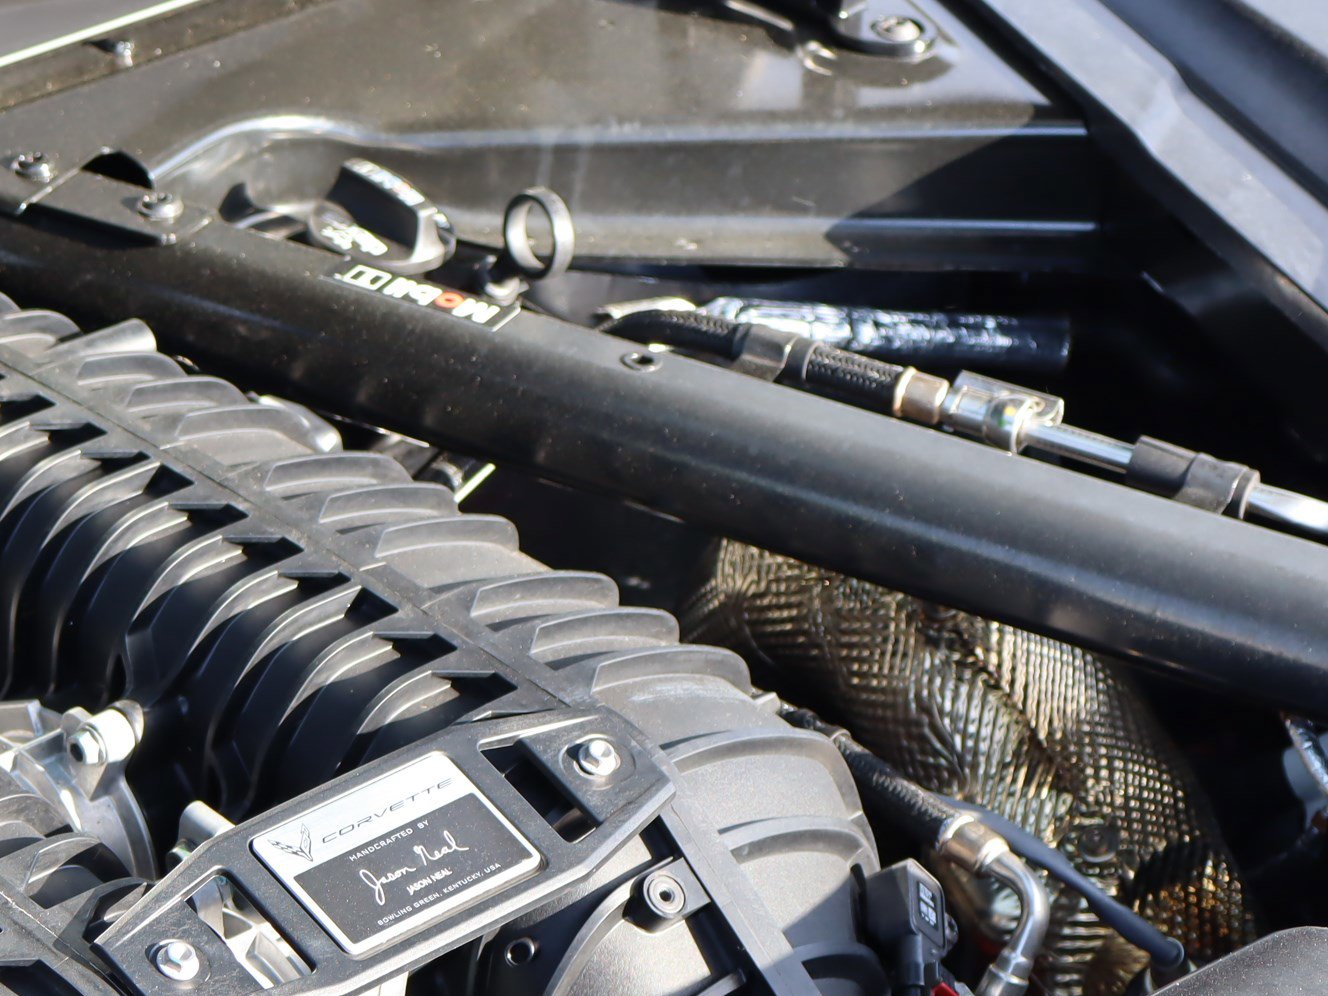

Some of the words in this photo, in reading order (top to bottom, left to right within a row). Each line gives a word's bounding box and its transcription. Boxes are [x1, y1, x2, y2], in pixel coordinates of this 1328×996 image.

[382, 276, 500, 324] Mobil
[322, 778, 452, 843] CORVETTE
[349, 828, 413, 862] HANDCRAFTED
[417, 819, 430, 830] BY
[377, 906, 412, 926] BOWLING
[413, 892, 443, 909] GREEN,
[442, 871, 484, 893] KENTUCKY,
[484, 862, 502, 874] USA
[406, 876, 433, 896] JASON
[431, 867, 453, 884] NEAL
